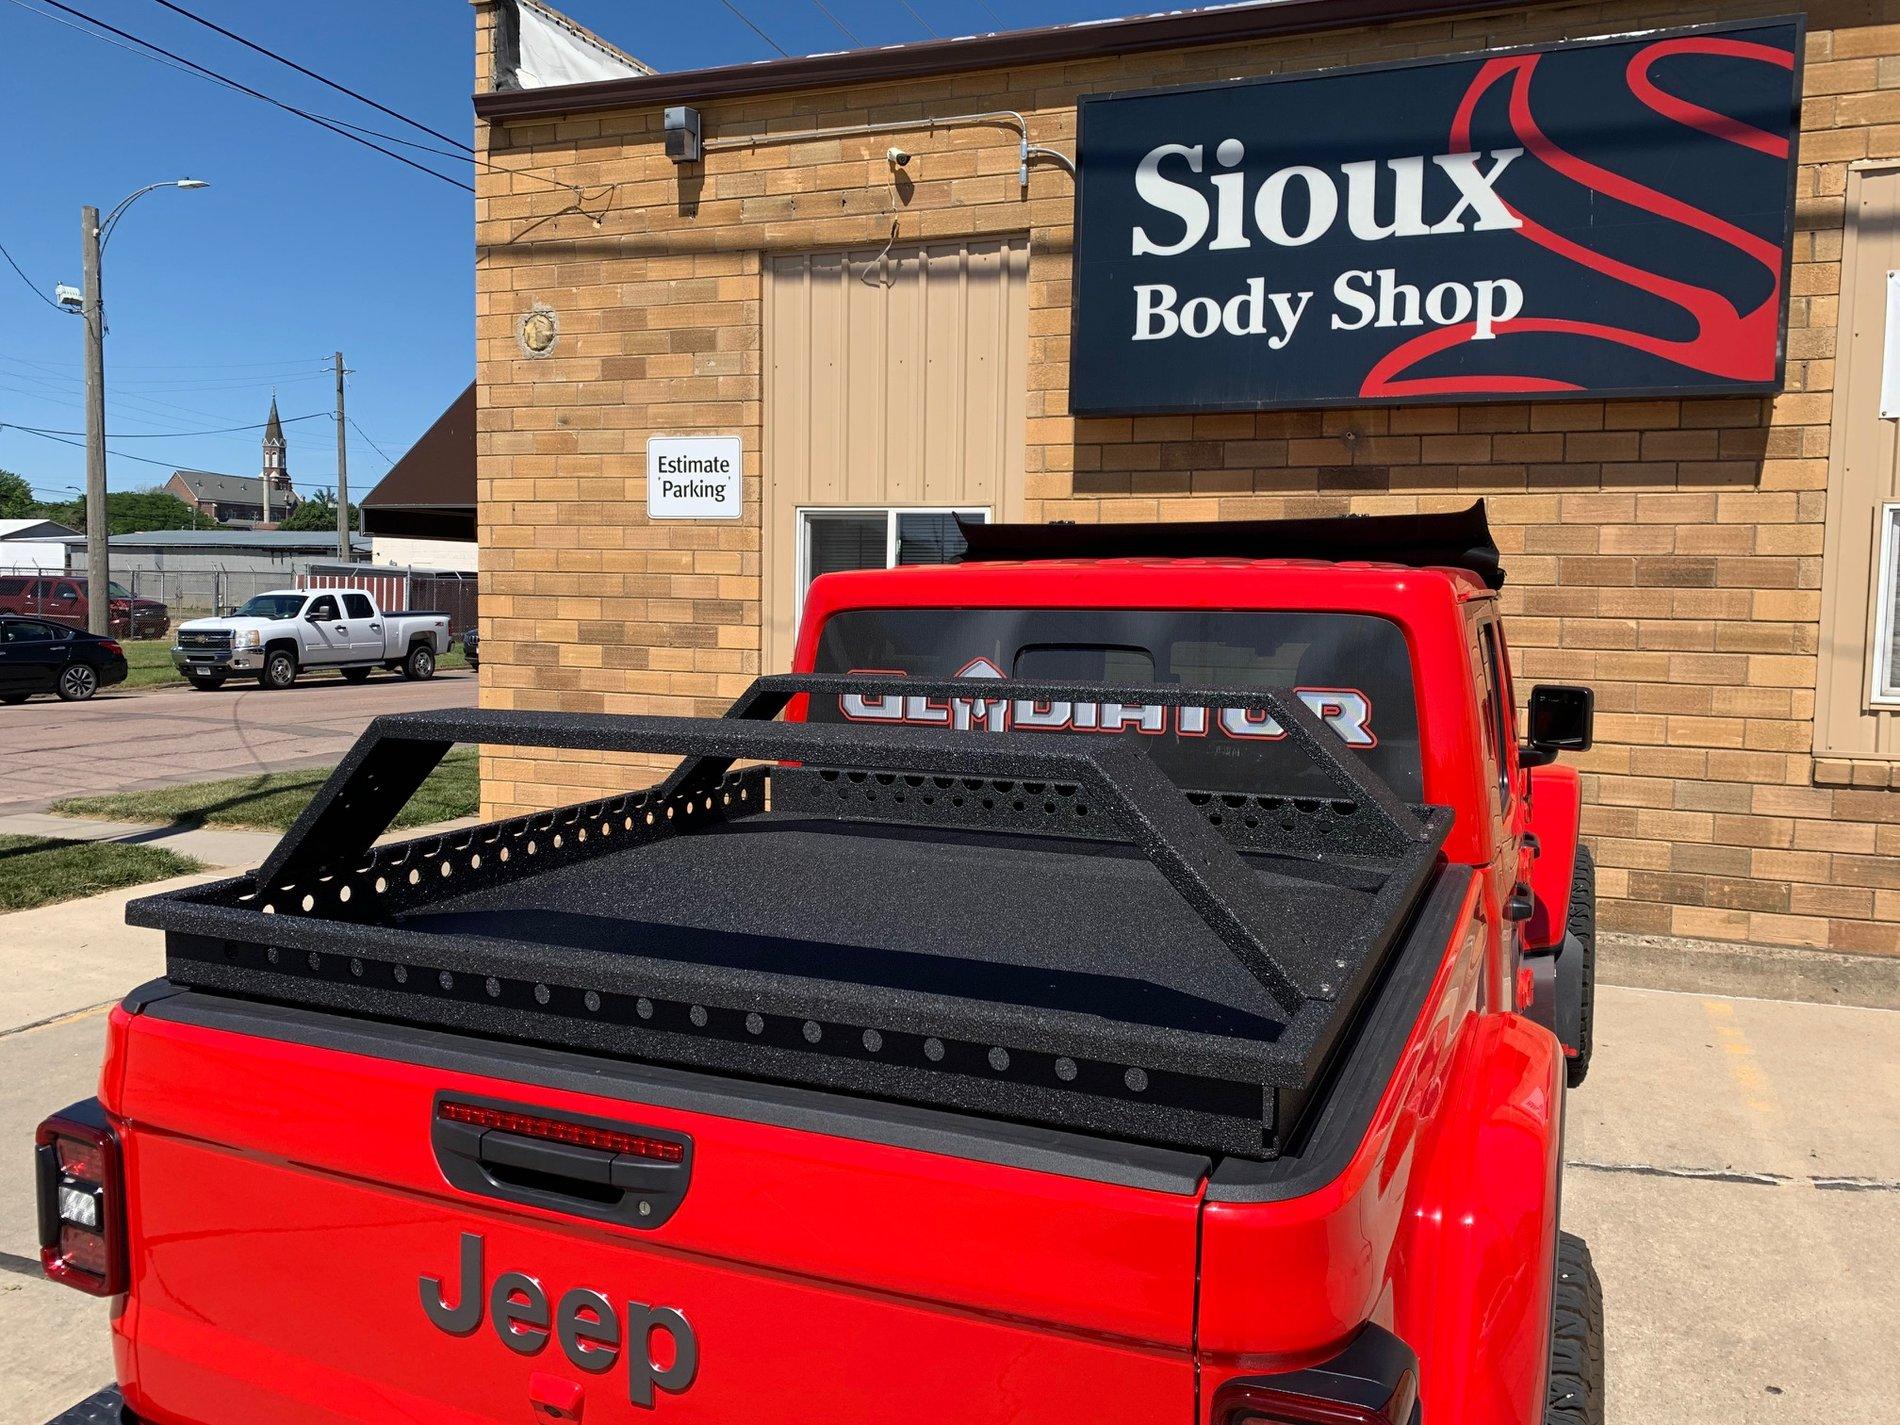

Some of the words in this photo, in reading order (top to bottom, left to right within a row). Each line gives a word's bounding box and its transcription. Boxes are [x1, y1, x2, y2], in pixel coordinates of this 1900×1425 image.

[1131, 138, 1524, 257] Sioux
[1131, 276, 1314, 350] Body
[1331, 268, 1524, 341] Shop
[658, 454, 730, 474] Estimate
[662, 479, 727, 503] Parking
[418, 1231, 699, 1411] Jeep
